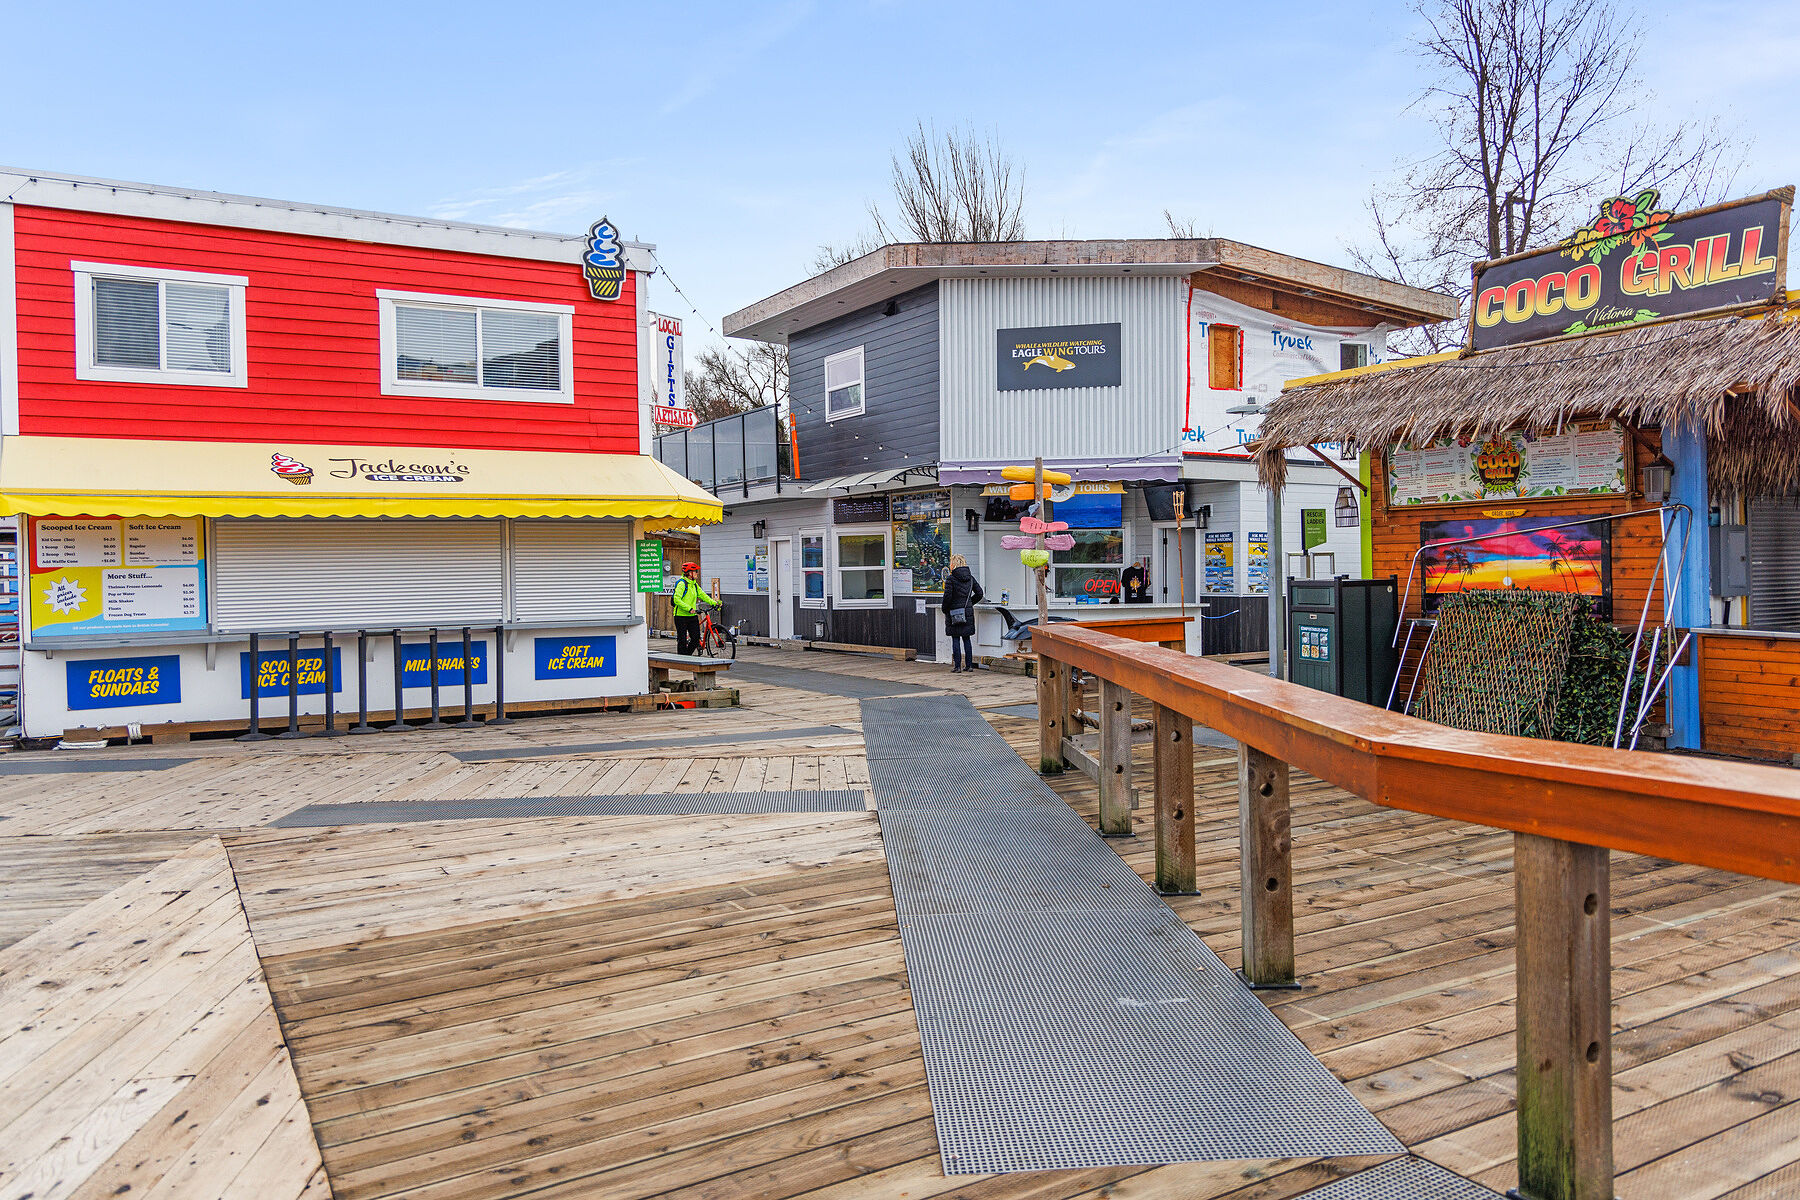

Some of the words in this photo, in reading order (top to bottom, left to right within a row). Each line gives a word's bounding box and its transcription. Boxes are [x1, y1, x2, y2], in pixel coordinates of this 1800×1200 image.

[1476, 263, 1602, 329] COCO
[1620, 225, 1778, 297] GRILL
[1585, 304, 1636, 324] Victoria
[658, 317, 682, 337] LOCAL
[1271, 330, 1313, 351] Tyvek
[666, 335, 676, 407] GIFTS
[656, 407, 694, 426] ARTISANS
[328, 458, 470, 478] Jackson's
[1478, 452, 1520, 470] COCO
[1485, 467, 1514, 479] GRILL
[1079, 484, 1110, 492] TOURS
[1085, 579, 1121, 593] OPEN
[57, 594, 76, 603] include
[562, 645, 590, 658] SOFT
[404, 656, 480, 672] MILSHAKS
[548, 657, 566, 670] ICE
[567, 656, 604, 670] CREAM
[88, 667, 143, 684] FLOATS
[147, 666, 159, 680] &
[258, 674, 278, 687] ICE
[281, 670, 326, 686] CEAM
[90, 681, 160, 698] SUNDAES
